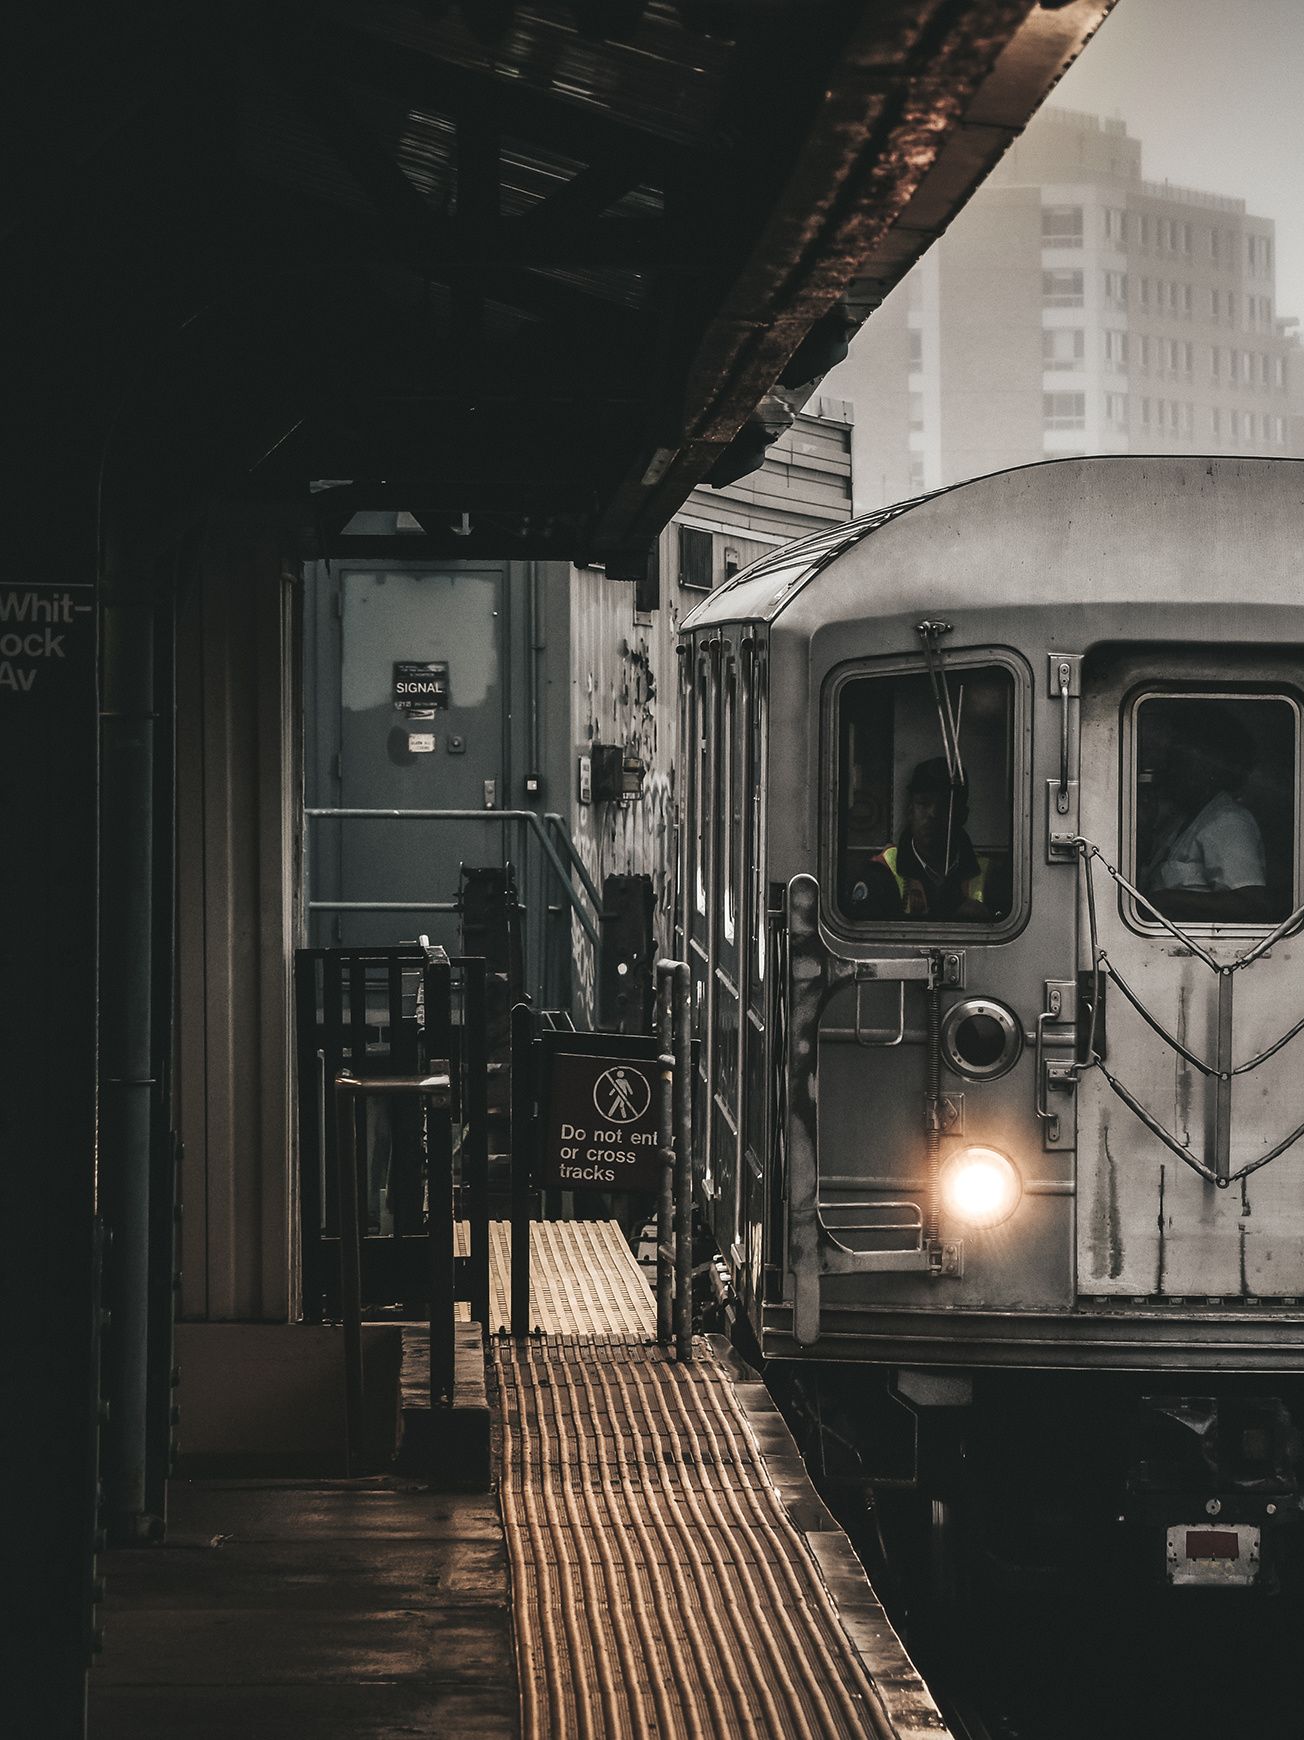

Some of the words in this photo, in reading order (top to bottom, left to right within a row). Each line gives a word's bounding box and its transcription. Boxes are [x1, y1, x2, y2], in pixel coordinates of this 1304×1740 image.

[0, 592, 92, 623] Whit-
[0, 627, 65, 658] ock
[0, 661, 37, 691] Av
[396, 682, 443, 694] SIGNAL
[560, 1124, 587, 1141] Do
[594, 1129, 623, 1144] not
[631, 1131, 676, 1147] entr
[560, 1147, 579, 1160] or
[586, 1148, 636, 1164] cross
[559, 1163, 615, 1182] tracks
